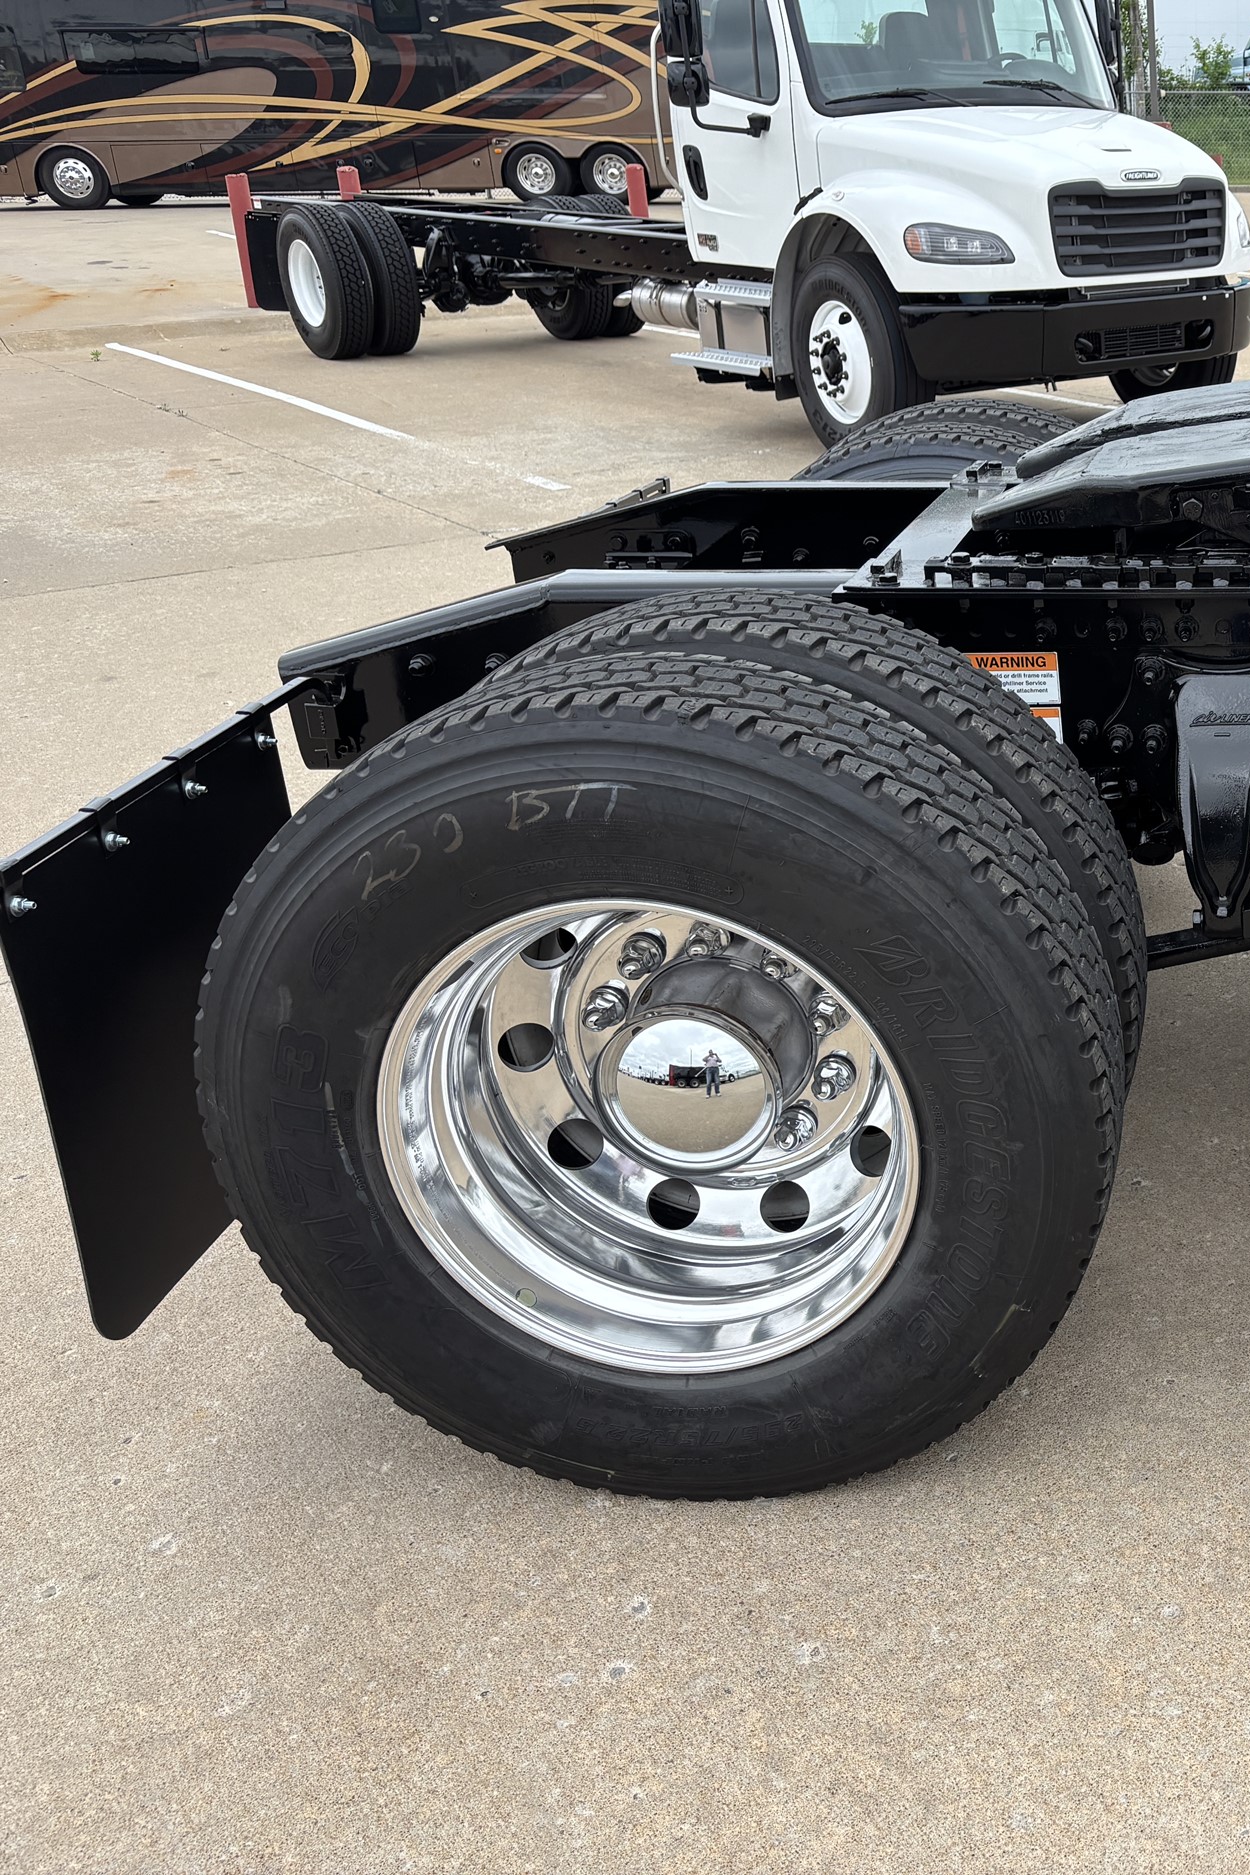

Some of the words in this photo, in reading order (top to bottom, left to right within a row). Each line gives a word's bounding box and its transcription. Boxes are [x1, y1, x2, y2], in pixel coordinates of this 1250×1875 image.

[1125, 171, 1158, 180] FREIGHTLINER
[975, 656, 1047, 668] WARNING
[1002, 680, 1024, 688] ghtliner
[853, 934, 1012, 1361] BRIDGESTONE
[271, 1023, 391, 1290] M713
[653, 1405, 727, 1418] RADIAL
[575, 1411, 803, 1447] 295/75R22.5
